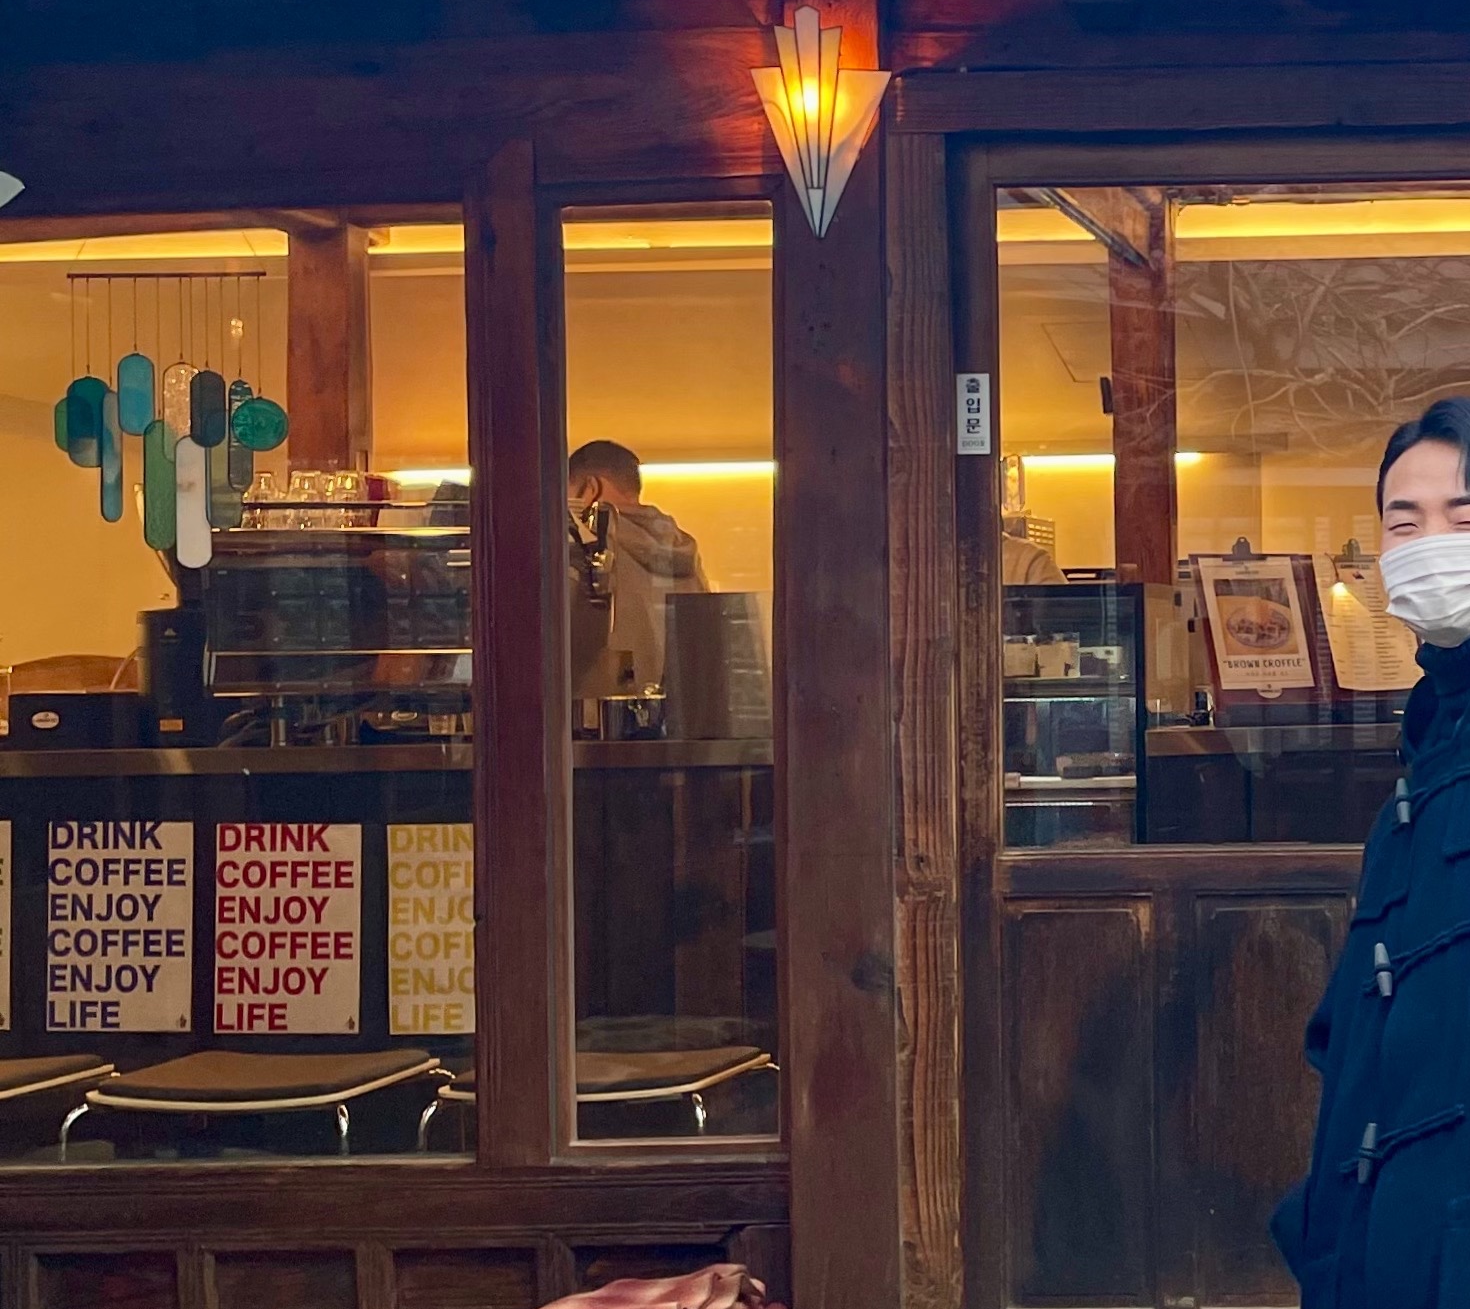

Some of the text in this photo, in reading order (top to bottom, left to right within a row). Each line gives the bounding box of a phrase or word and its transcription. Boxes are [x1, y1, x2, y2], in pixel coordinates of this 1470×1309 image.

[966, 377, 981, 434] 출입문
[50, 821, 162, 850] DRINK
[219, 824, 330, 852] DRINK
[48, 858, 186, 887] COFFEE
[216, 860, 354, 889] COFFEE
[49, 894, 162, 921] ENJOY
[218, 896, 330, 924] ENJOY
[47, 929, 186, 957] COFFEE
[215, 931, 354, 960] COFFEE
[48, 965, 160, 992] ENJOY
[216, 967, 329, 995] ENJOY
[48, 1001, 120, 1029] LIFE
[215, 1003, 288, 1031] LIFE
[391, 1003, 465, 1032] LIFE
